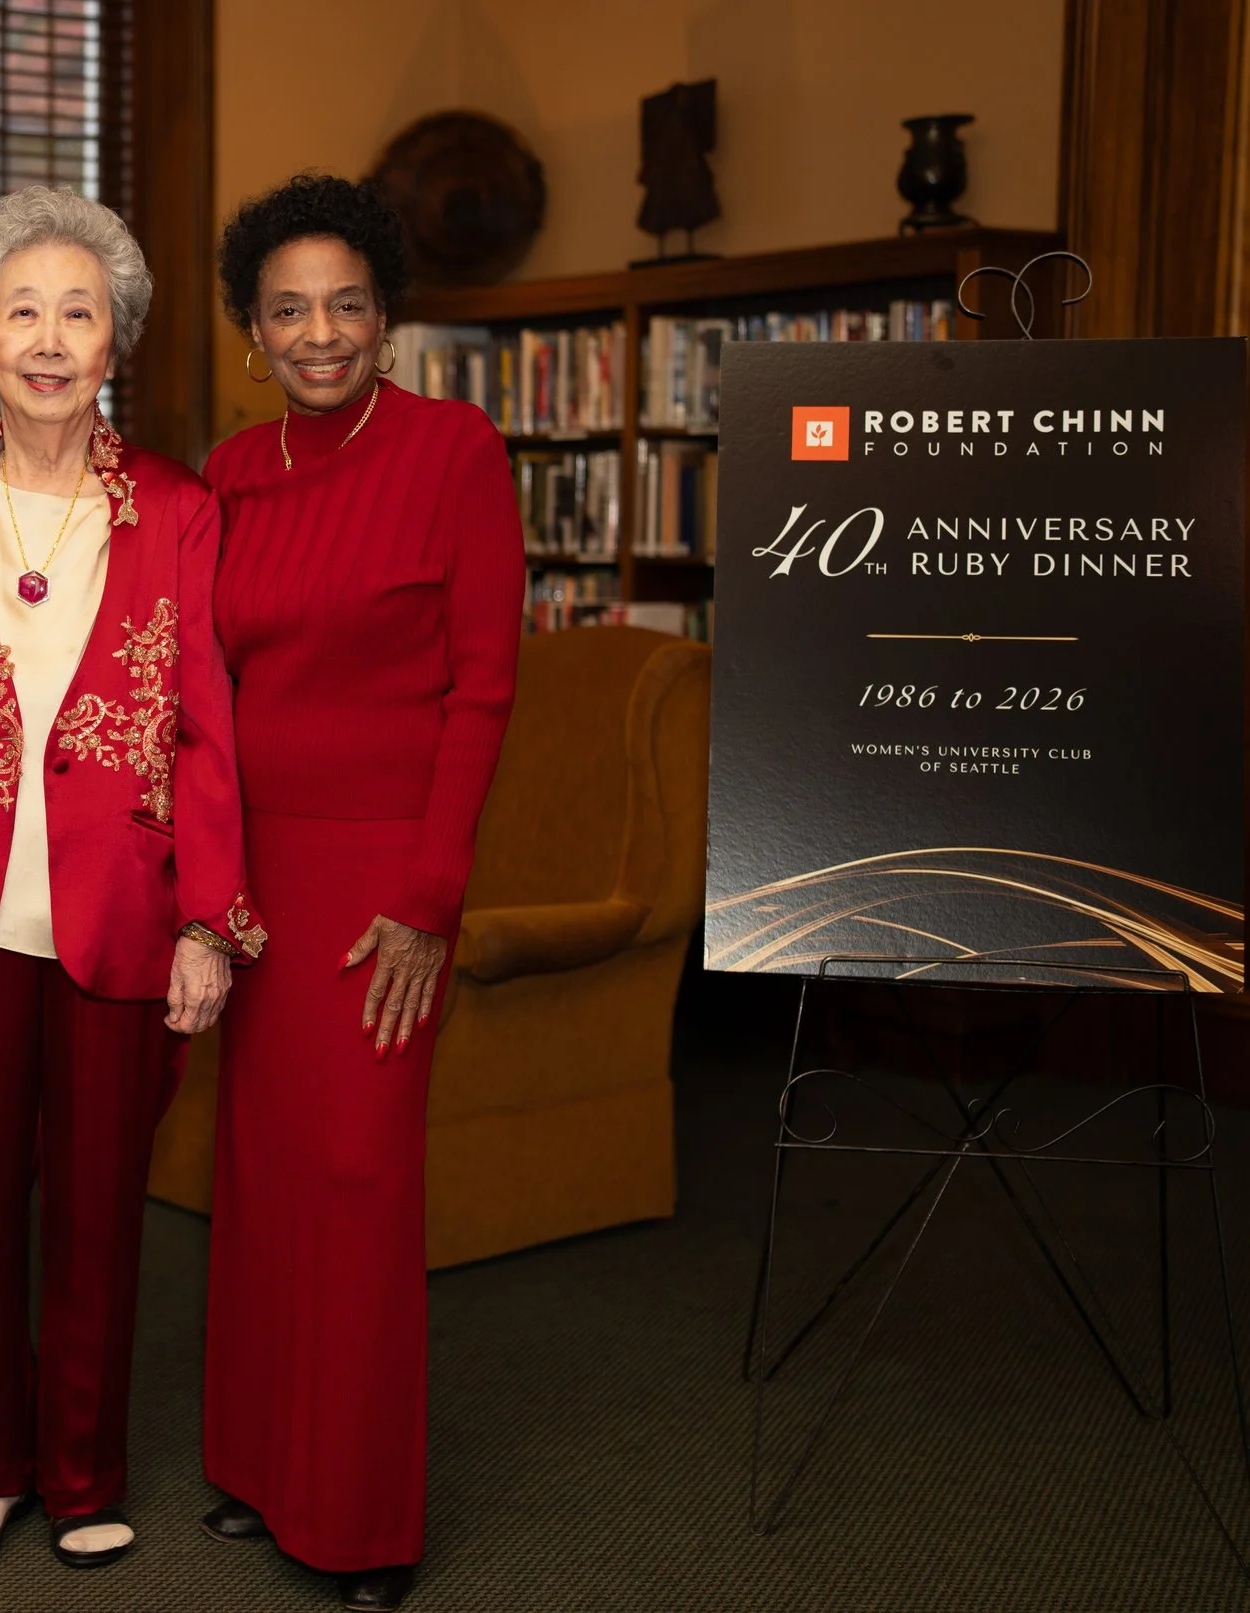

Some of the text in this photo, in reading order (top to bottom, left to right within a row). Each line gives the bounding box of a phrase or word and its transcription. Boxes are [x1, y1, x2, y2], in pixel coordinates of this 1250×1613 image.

[864, 409, 1164, 434] ROBERT CHINN
[864, 441, 1163, 457] FOUNDATION
[906, 517, 1196, 542] ANNIVERSARY
[912, 552, 1192, 578] RUBY DINNER
[859, 683, 1087, 711] 1986 to 2026
[851, 743, 1092, 760] WOMEN'S UNIVERSITY CLUB
[919, 761, 1020, 775] OF SEATTLE
